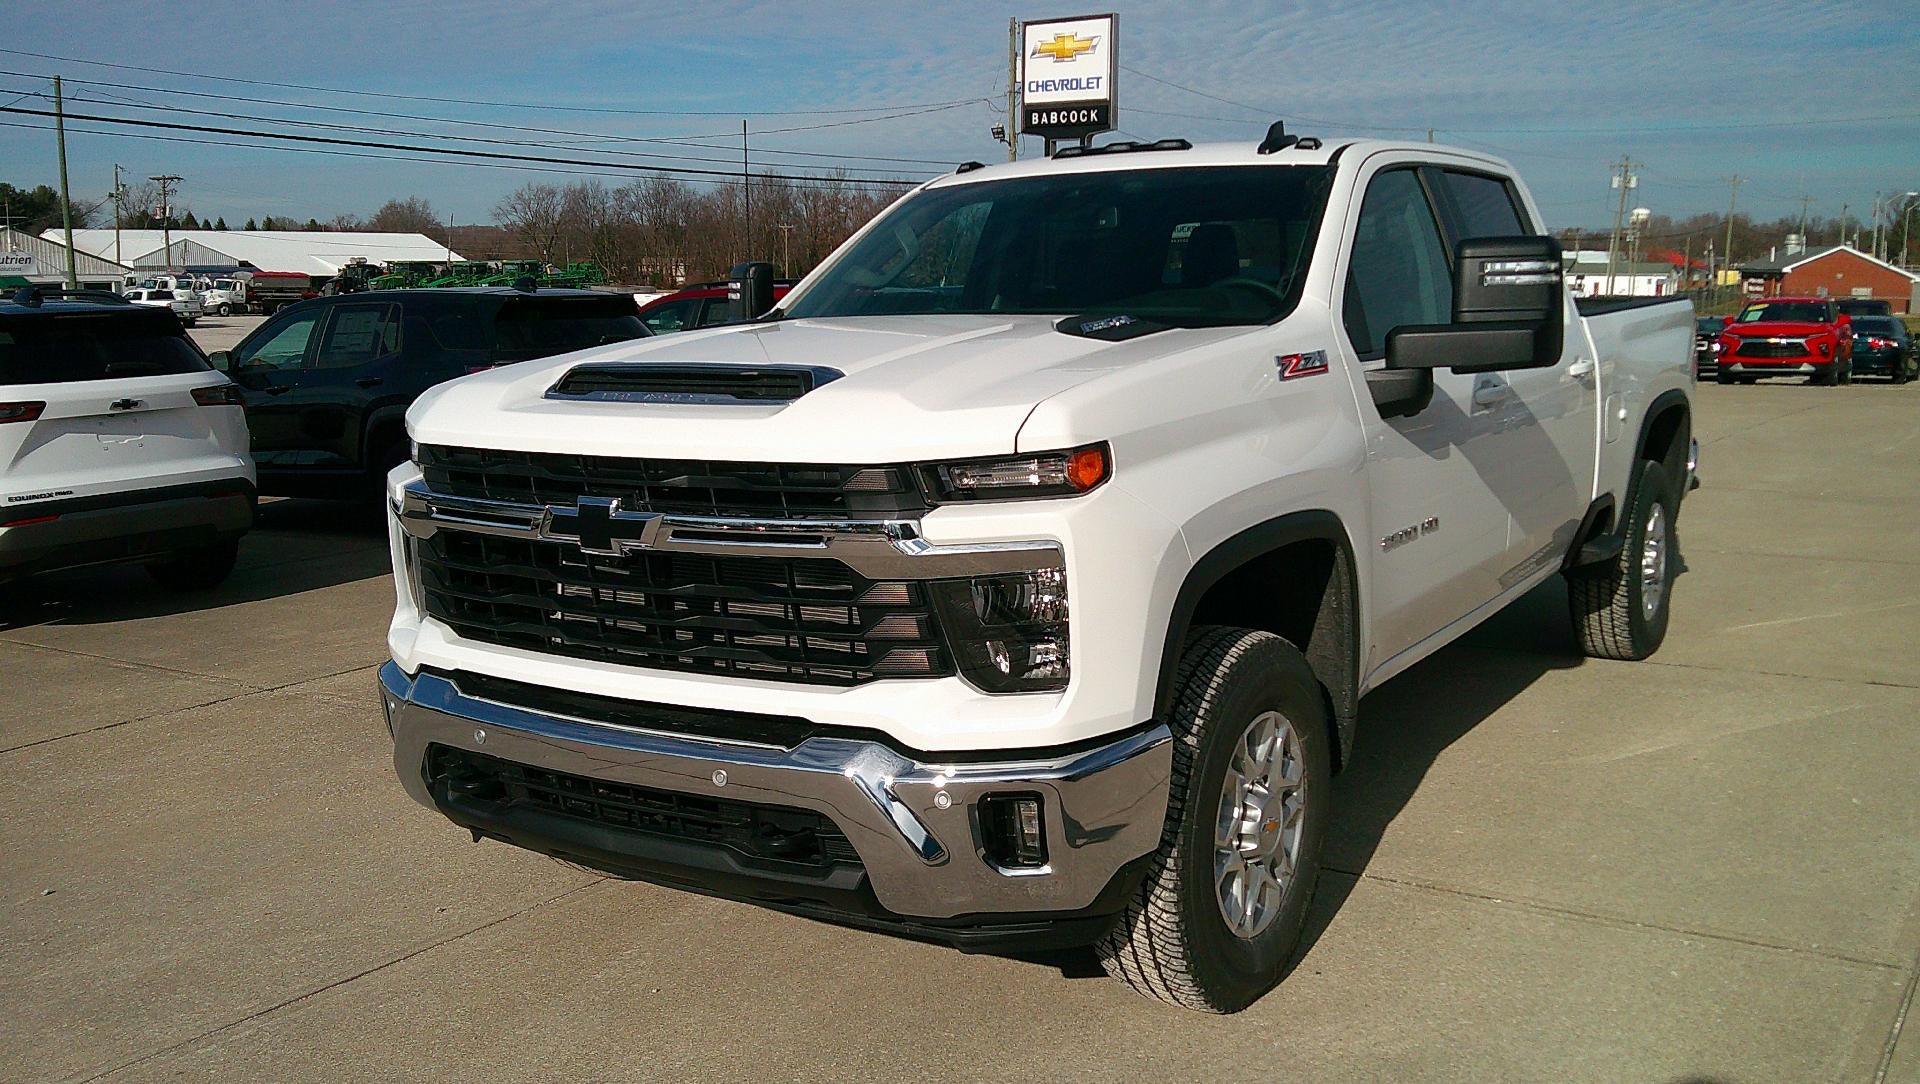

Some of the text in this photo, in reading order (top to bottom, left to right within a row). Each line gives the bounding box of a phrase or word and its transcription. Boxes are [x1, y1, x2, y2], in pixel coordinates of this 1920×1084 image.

[1028, 76, 1102, 93] CHEVROLET
[1031, 109, 1098, 125] BABCOCK
[0, 254, 32, 265] utrien
[7, 492, 54, 502] EQUINOX
